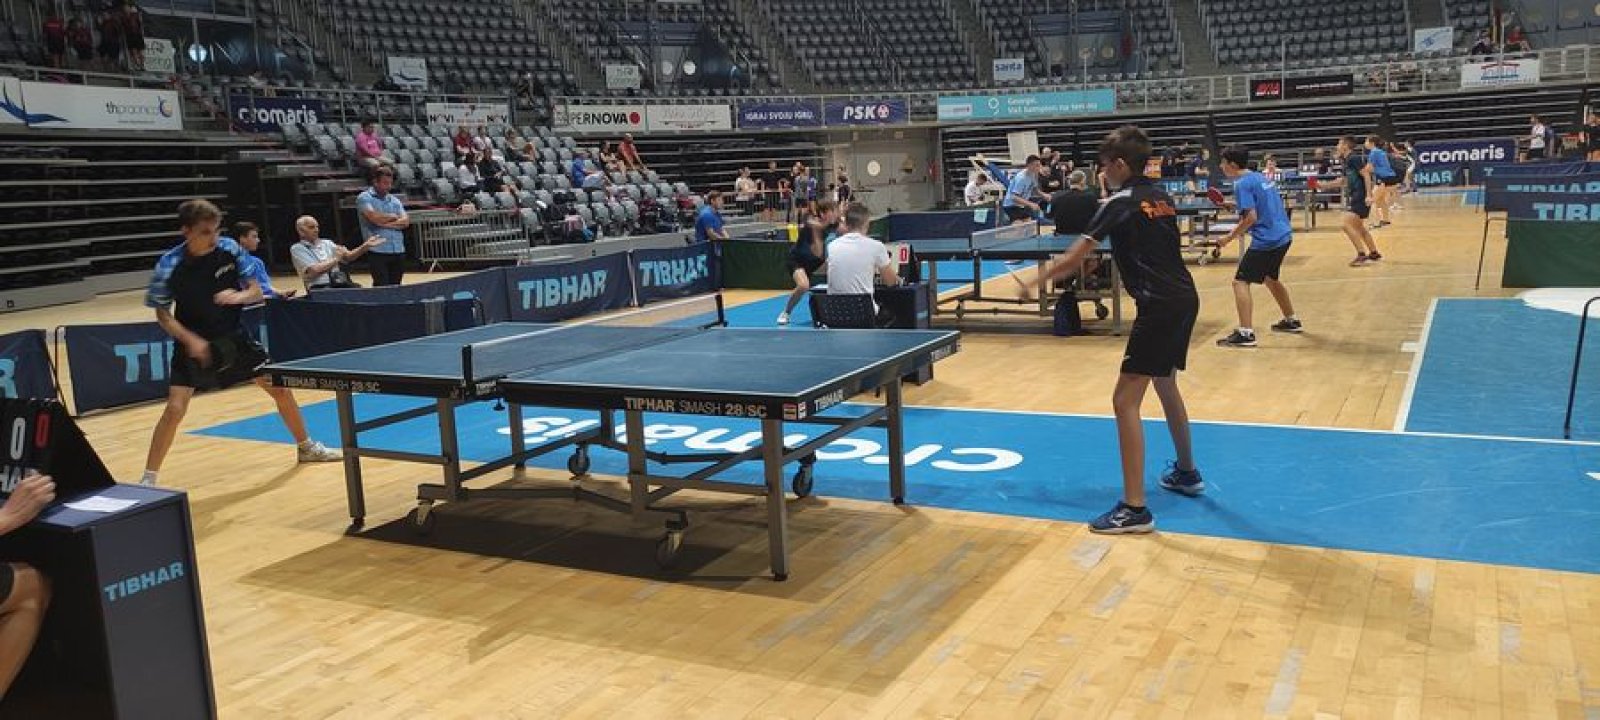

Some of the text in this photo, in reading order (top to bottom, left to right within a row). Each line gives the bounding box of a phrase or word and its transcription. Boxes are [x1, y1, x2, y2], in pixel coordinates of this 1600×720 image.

[843, 106, 876, 120] PSK
[1419, 143, 1505, 163] cromaris
[639, 253, 709, 287] TIBHAR
[518, 269, 608, 310] TIBHAR
[679, 400, 721, 415] SMASH
[814, 389, 844, 411] TIBHAR
[10, 412, 49, 460] 0 0
[104, 561, 184, 602] TIBHAR
